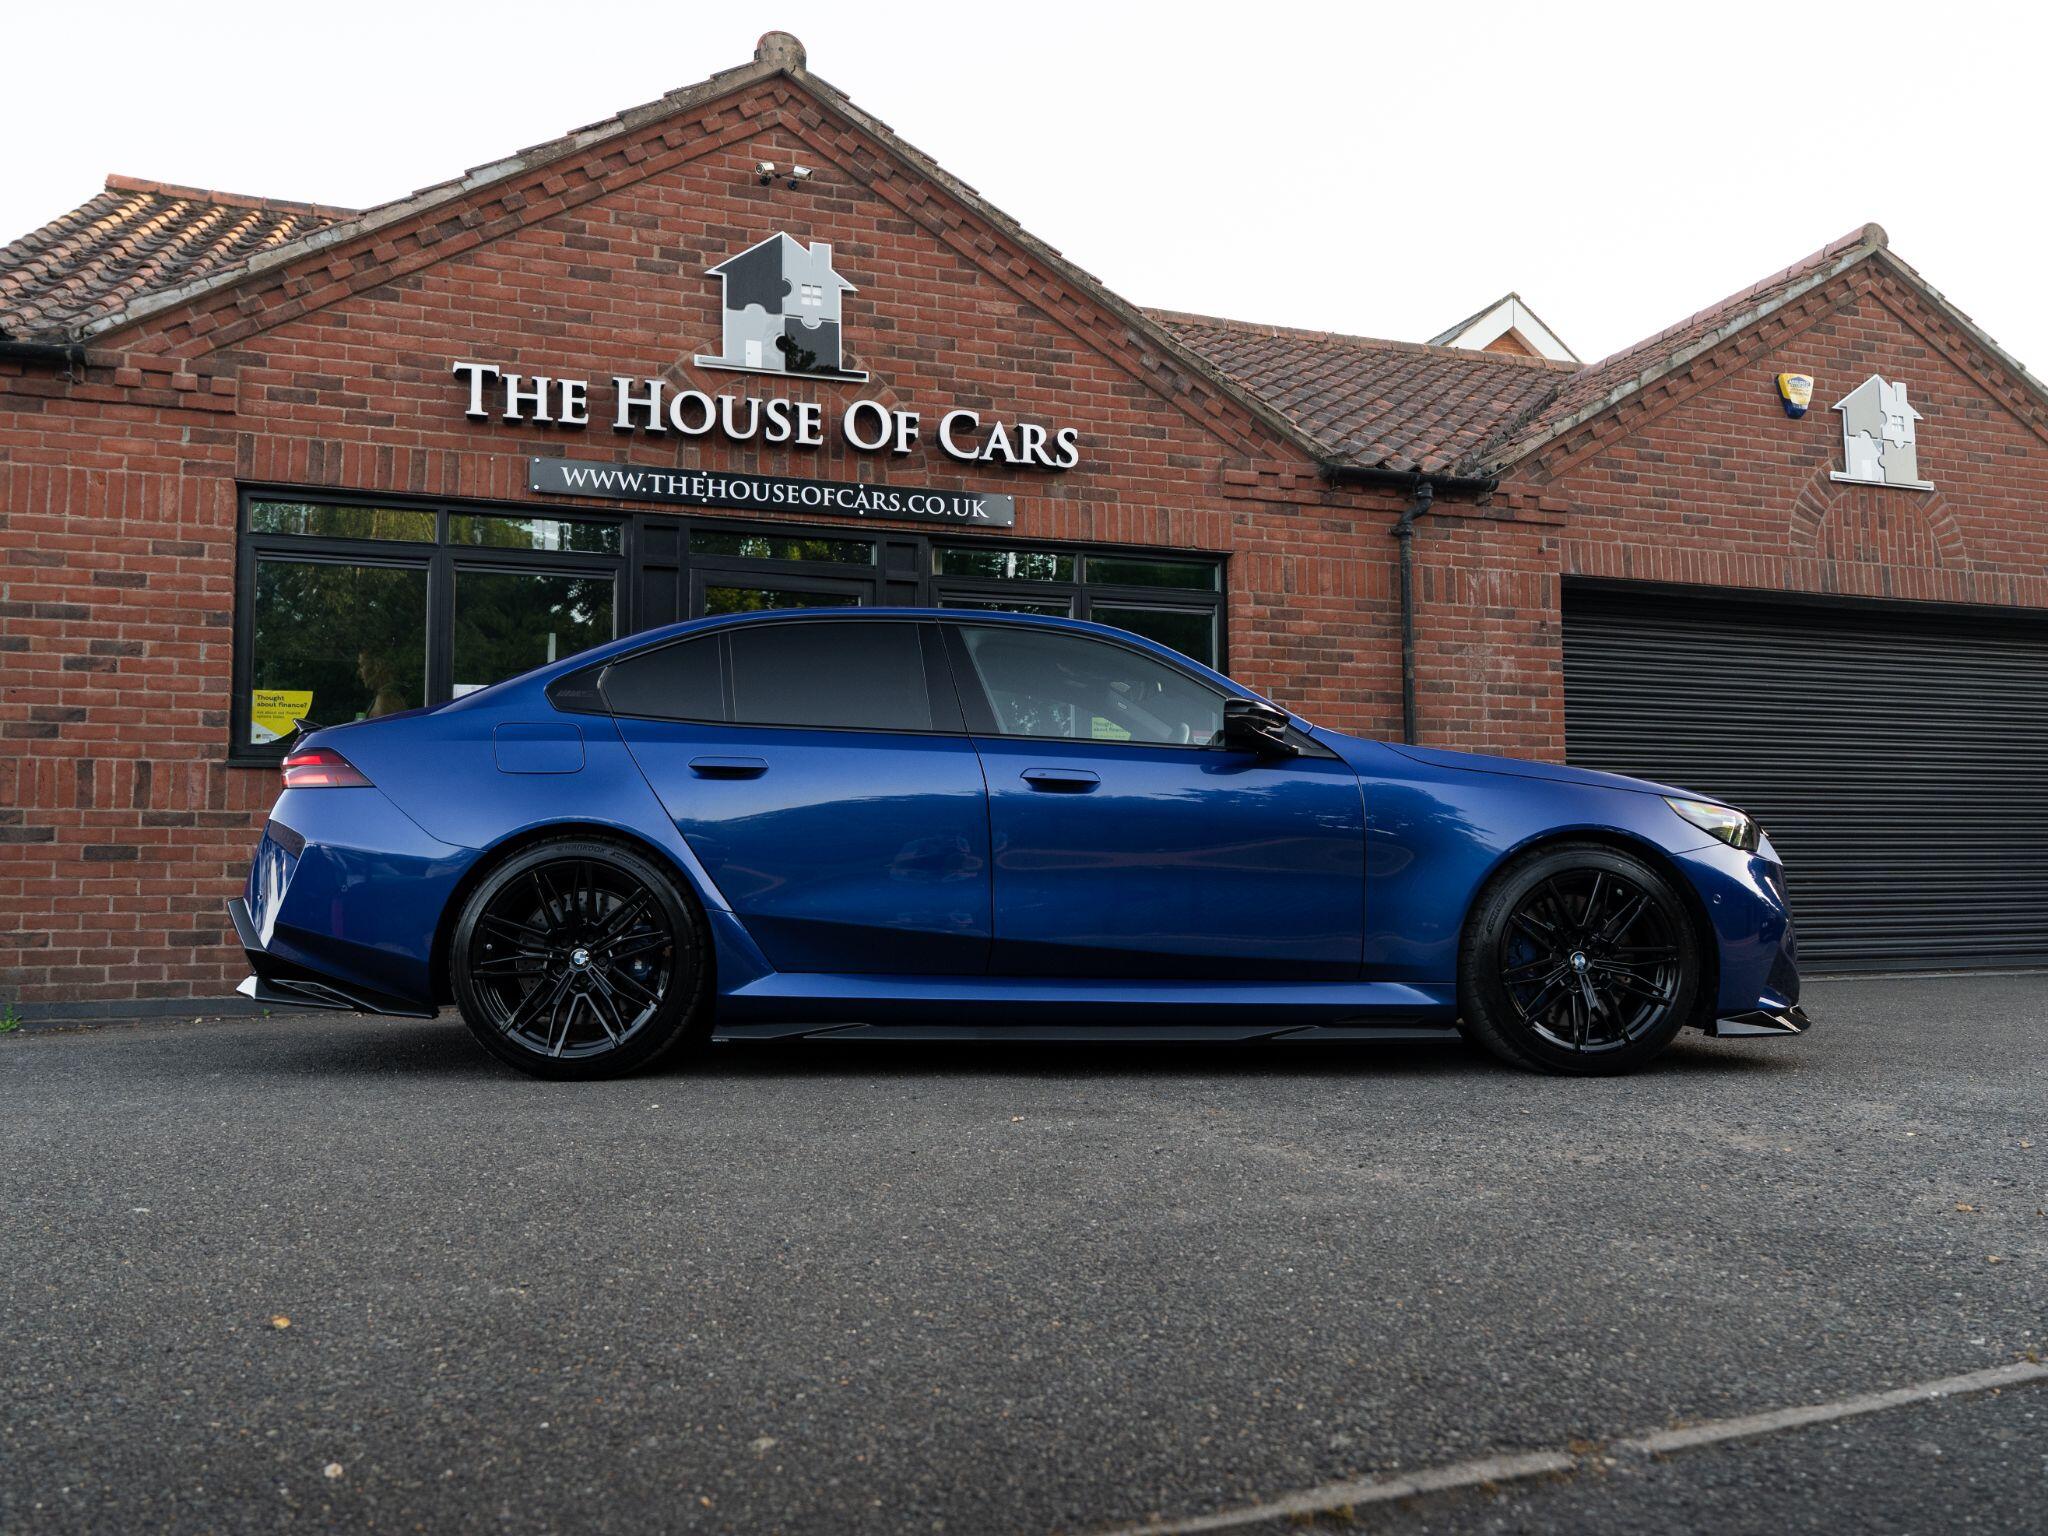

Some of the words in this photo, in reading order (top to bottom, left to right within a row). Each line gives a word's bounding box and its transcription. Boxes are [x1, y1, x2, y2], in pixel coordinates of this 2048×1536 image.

[453, 361, 589, 424] THE
[612, 377, 824, 445] HOUSE
[843, 400, 920, 452] OF
[939, 410, 1079, 468] CARS
[560, 466, 990, 519] WWW.THEHOUSEOFCARS.CO.UK
